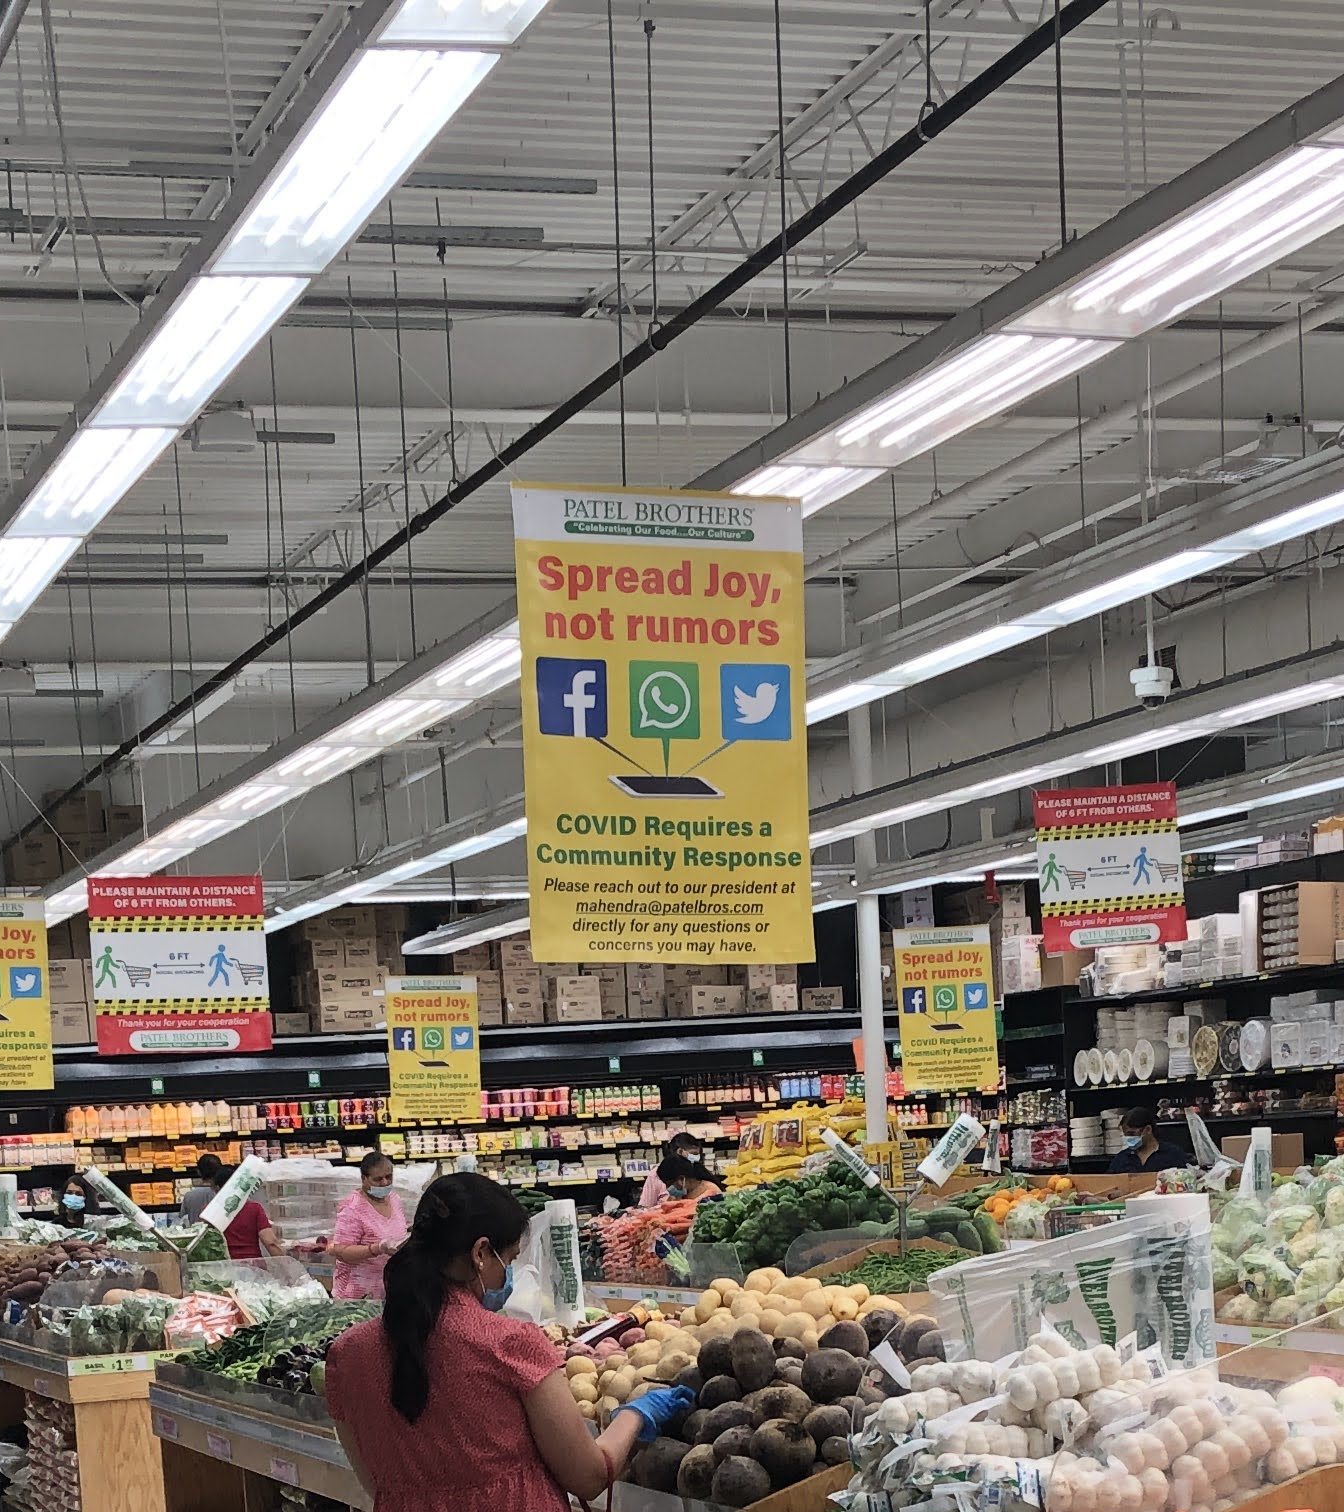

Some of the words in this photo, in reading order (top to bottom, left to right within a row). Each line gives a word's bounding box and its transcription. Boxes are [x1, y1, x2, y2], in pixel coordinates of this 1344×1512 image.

[564, 499, 628, 520] PATEL
[635, 503, 753, 526] BROTHERS
[635, 526, 651, 534] Our
[537, 555, 691, 601] Spread
[704, 564, 781, 607] Joy,
[545, 608, 615, 641] not
[627, 613, 780, 646] rumors
[1038, 798, 1071, 808] PLEASE
[1074, 796, 1117, 806] MAINTAIN
[1119, 795, 1125, 803] A
[1127, 792, 1170, 802] DISTANCE
[1056, 810, 1067, 818] OF
[1077, 808, 1087, 816] FT
[1089, 807, 1114, 816] FROM
[557, 814, 636, 835] COVID
[645, 816, 753, 840] Requires
[760, 821, 772, 836] a
[537, 843, 676, 871] Community
[684, 846, 801, 871] Response
[93, 887, 134, 896] PLEASE
[137, 887, 190, 895] MAINTAIN
[193, 887, 200, 895] A
[203, 886, 256, 895] DISTANCE
[545, 878, 589, 892] Please
[594, 880, 633, 893] reach
[638, 882, 661, 893] out
[665, 882, 678, 893] to
[683, 884, 707, 893] our
[711, 880, 777, 897] president
[782, 882, 795, 893] at
[114, 899, 129, 908] OF
[132, 899, 138, 908] 6
[141, 899, 153, 907] FT
[156, 899, 187, 907] FROM
[190, 898, 236, 907] OTHERS.
[576, 900, 763, 916] mahendra@patelbros.com
[2, 926, 36, 942] Joy,
[573, 919, 626, 935] directly
[630, 920, 649, 932] for
[653, 922, 678, 936] any
[683, 920, 750, 936] questions
[755, 922, 770, 932] or
[589, 939, 653, 951] concerns
[657, 941, 682, 954] you
[687, 941, 714, 955] may
[720, 939, 756, 951] have.
[178, 952, 188, 960] FT
[902, 951, 953, 967] Spread
[957, 950, 983, 964] Joy,
[905, 969, 927, 981] not
[932, 967, 982, 979] rumors
[393, 997, 442, 1010] Spread
[446, 997, 470, 1009] Joy,
[118, 1019, 143, 1027] Thank
[146, 1020, 161, 1028] you
[163, 1018, 175, 1026] for
[177, 1019, 196, 1028] your
[199, 1017, 249, 1027] cooperation
[395, 1012, 417, 1022] not
[421, 1012, 470, 1022] rumors
